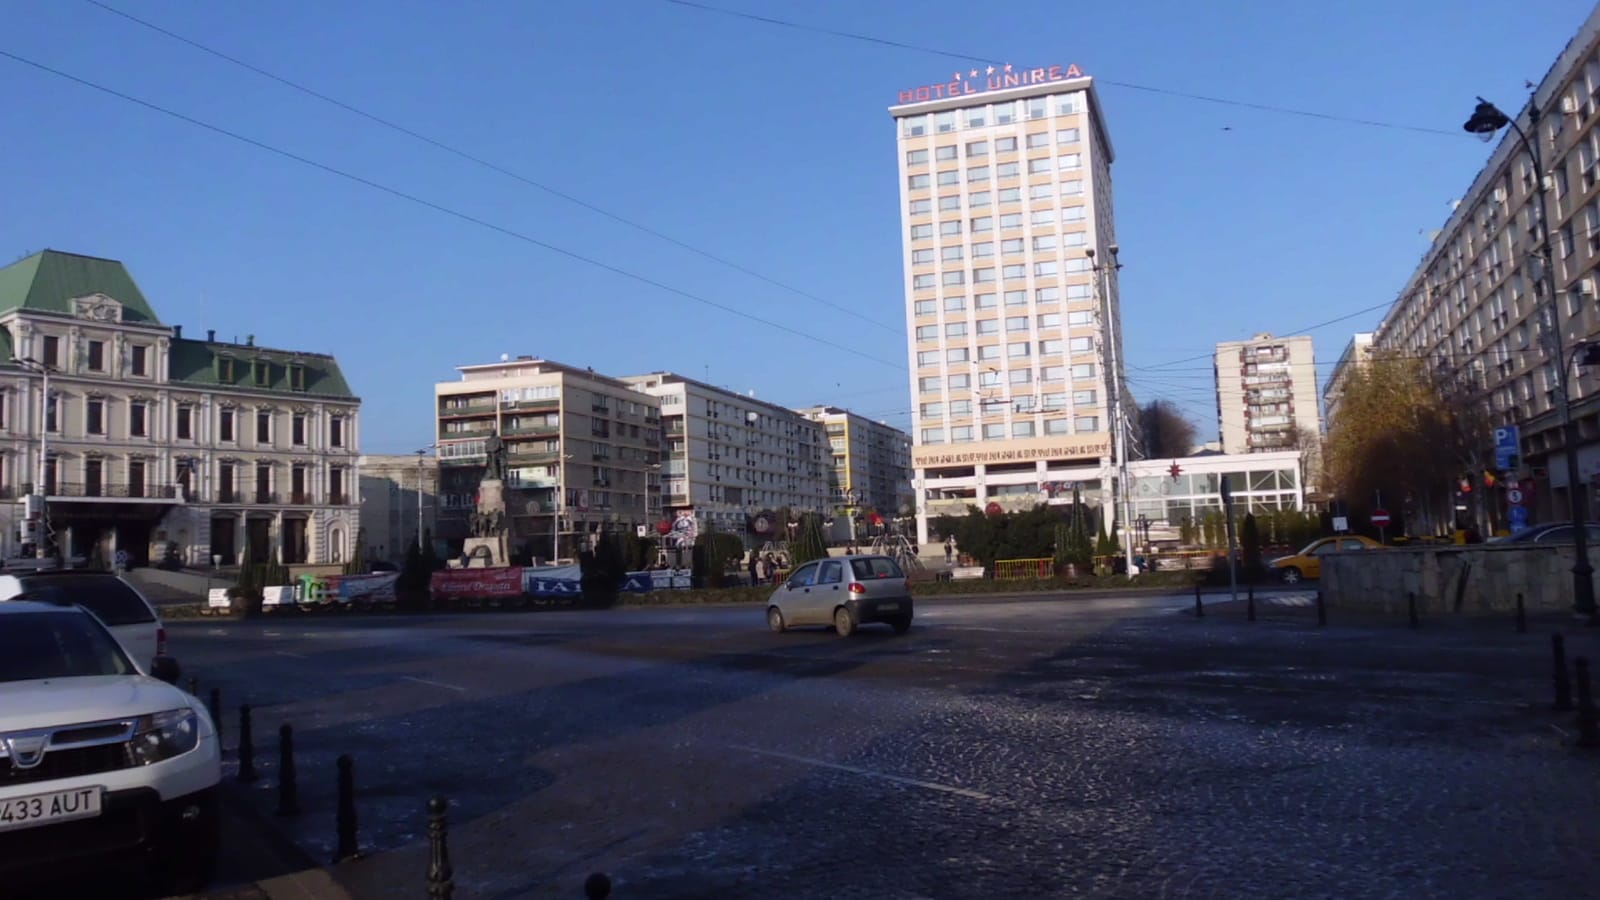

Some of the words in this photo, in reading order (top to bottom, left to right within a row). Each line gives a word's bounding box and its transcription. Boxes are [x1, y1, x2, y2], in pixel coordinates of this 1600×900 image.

[899, 81, 976, 102] HOTEL
[988, 64, 1082, 90] UNIREA
[1495, 429, 1508, 445] P
[0, 798, 42, 822] 433
[50, 790, 93, 815] AUT
